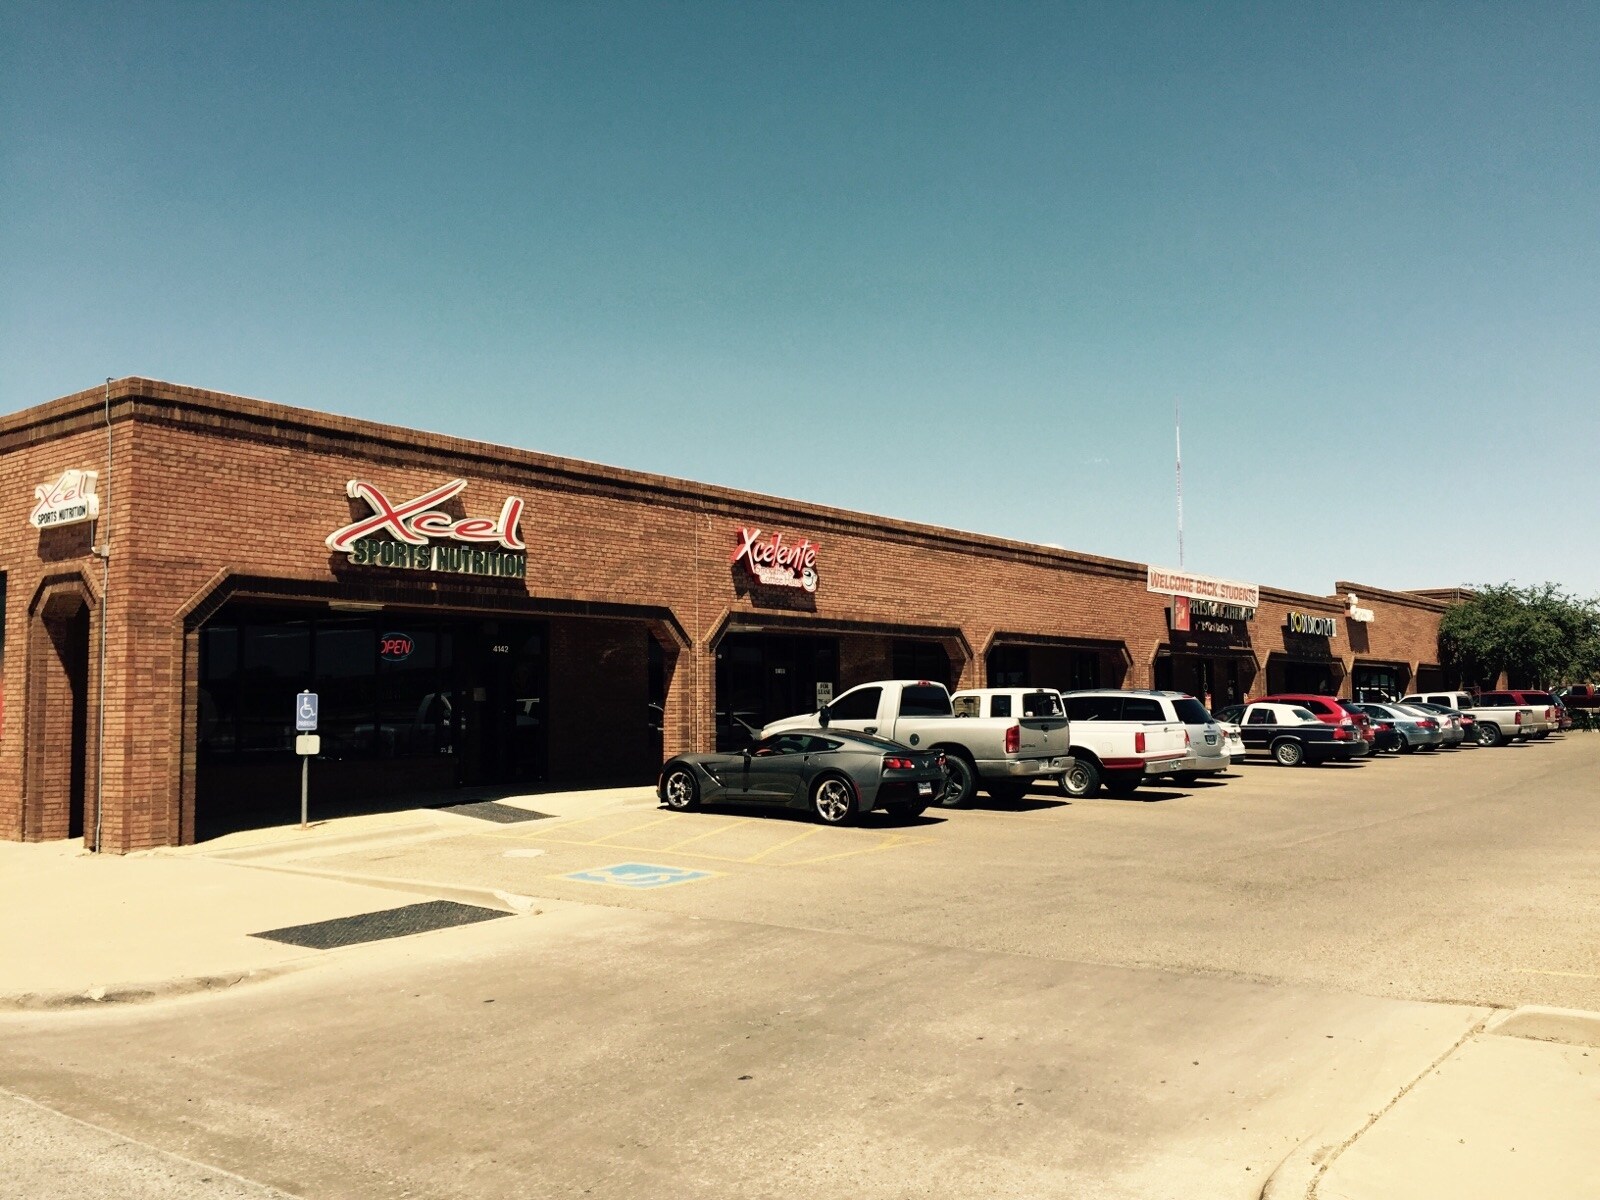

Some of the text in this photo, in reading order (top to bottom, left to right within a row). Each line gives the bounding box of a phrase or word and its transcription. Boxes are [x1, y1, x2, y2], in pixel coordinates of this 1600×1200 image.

[32, 473, 86, 519] Xcel
[37, 505, 86, 526] SPORTS NUTRITION
[328, 479, 525, 551] Xcel
[351, 538, 527, 579] SPORTS NUTRITION
[732, 527, 818, 573] Xcelente
[1150, 572, 1257, 603] WELCOME BACK STUDENTS
[492, 645, 509, 653] 4142
